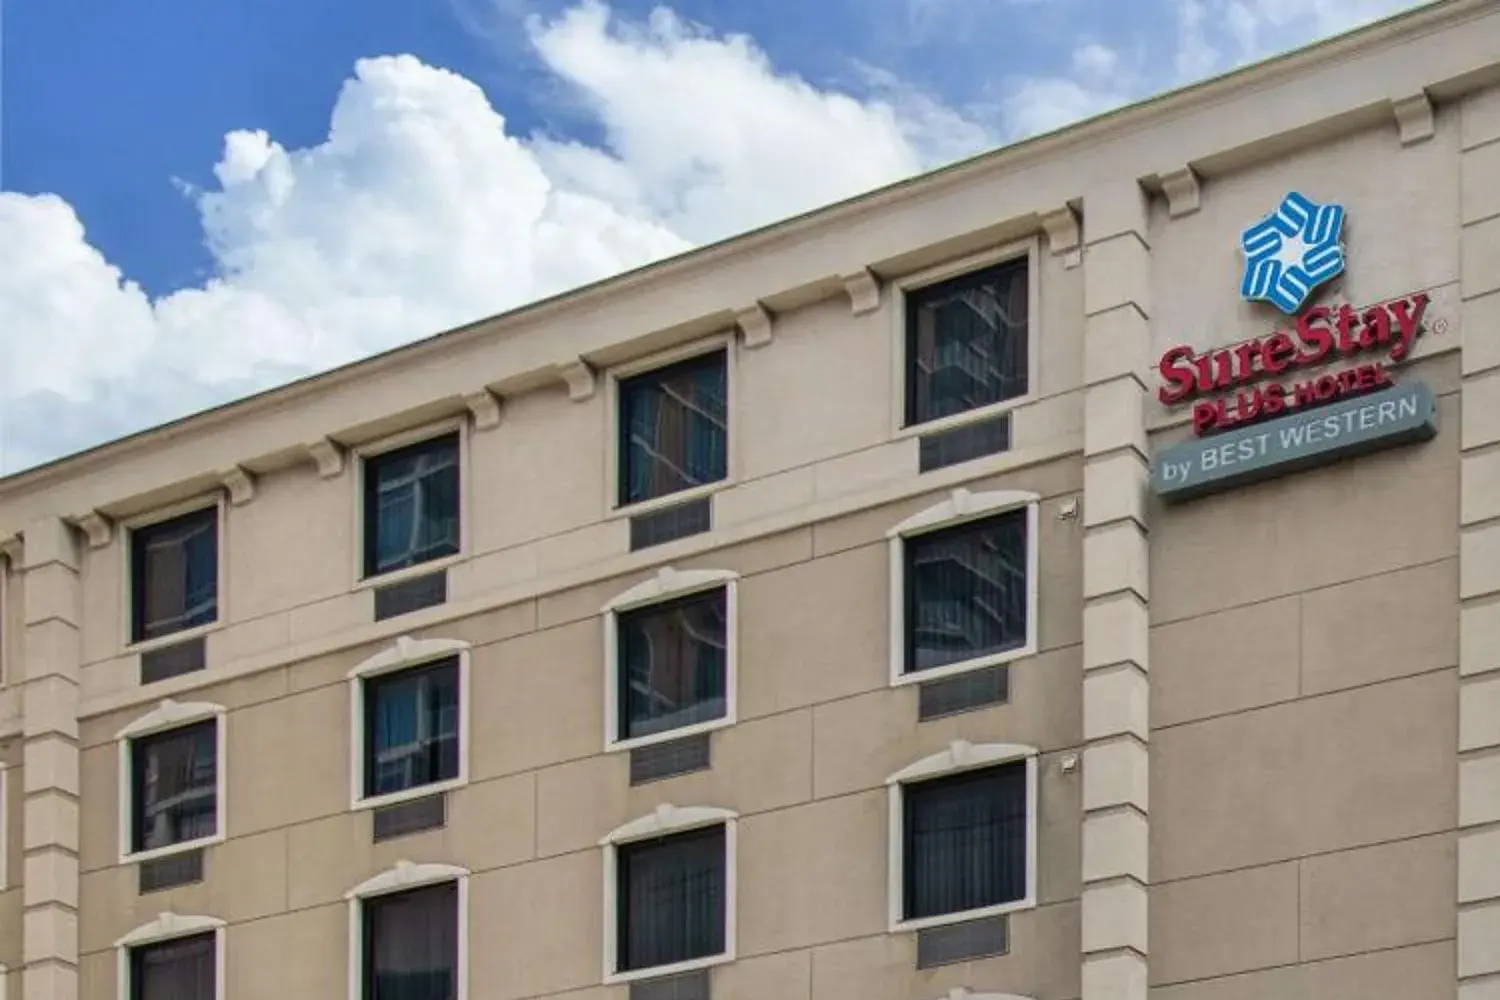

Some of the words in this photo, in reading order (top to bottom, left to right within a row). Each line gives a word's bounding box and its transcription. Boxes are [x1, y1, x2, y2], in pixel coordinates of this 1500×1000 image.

[1159, 294, 1431, 405] SureStay
[1162, 460, 1192, 484] by
[1200, 433, 1272, 471] BEST
[1279, 394, 1419, 450] WESTERN
[1193, 382, 1285, 436] PLUS
[1293, 362, 1394, 405] HOTEL
